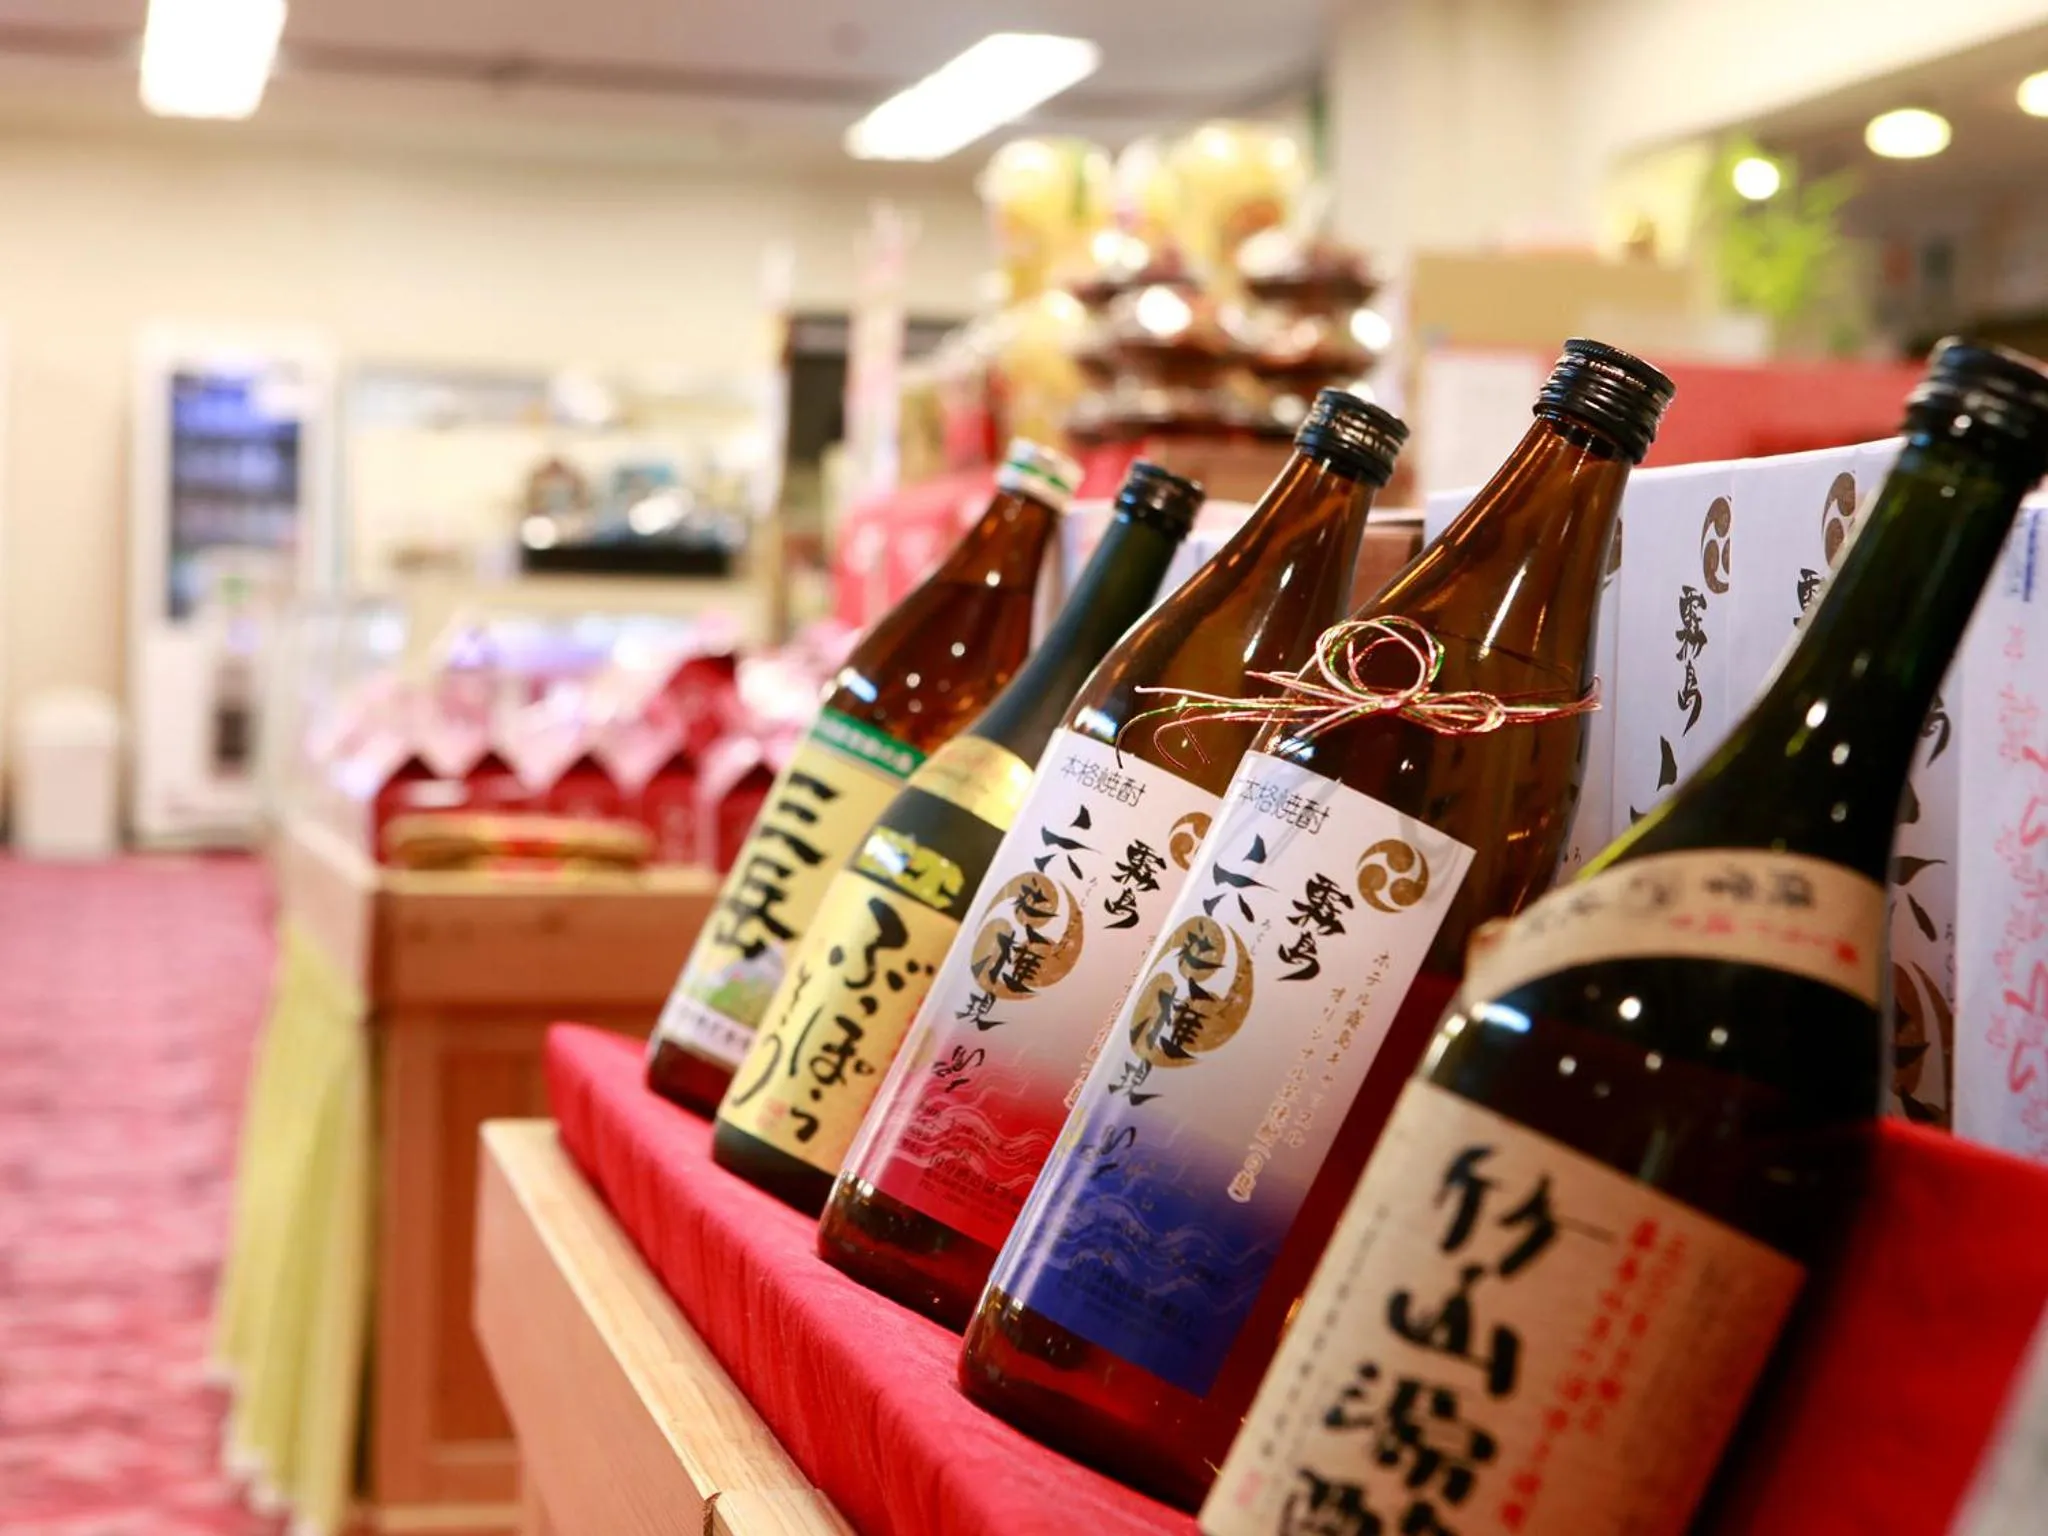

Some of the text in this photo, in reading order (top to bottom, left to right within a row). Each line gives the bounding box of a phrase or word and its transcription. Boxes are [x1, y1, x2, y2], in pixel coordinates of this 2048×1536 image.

[1675, 584, 1709, 737] 霧島
[1059, 754, 1147, 808] 本格焼酎
[1238, 777, 1331, 835] 本格焼酎
[1104, 839, 1168, 929] 霧島
[1277, 872, 1355, 981] 霧島
